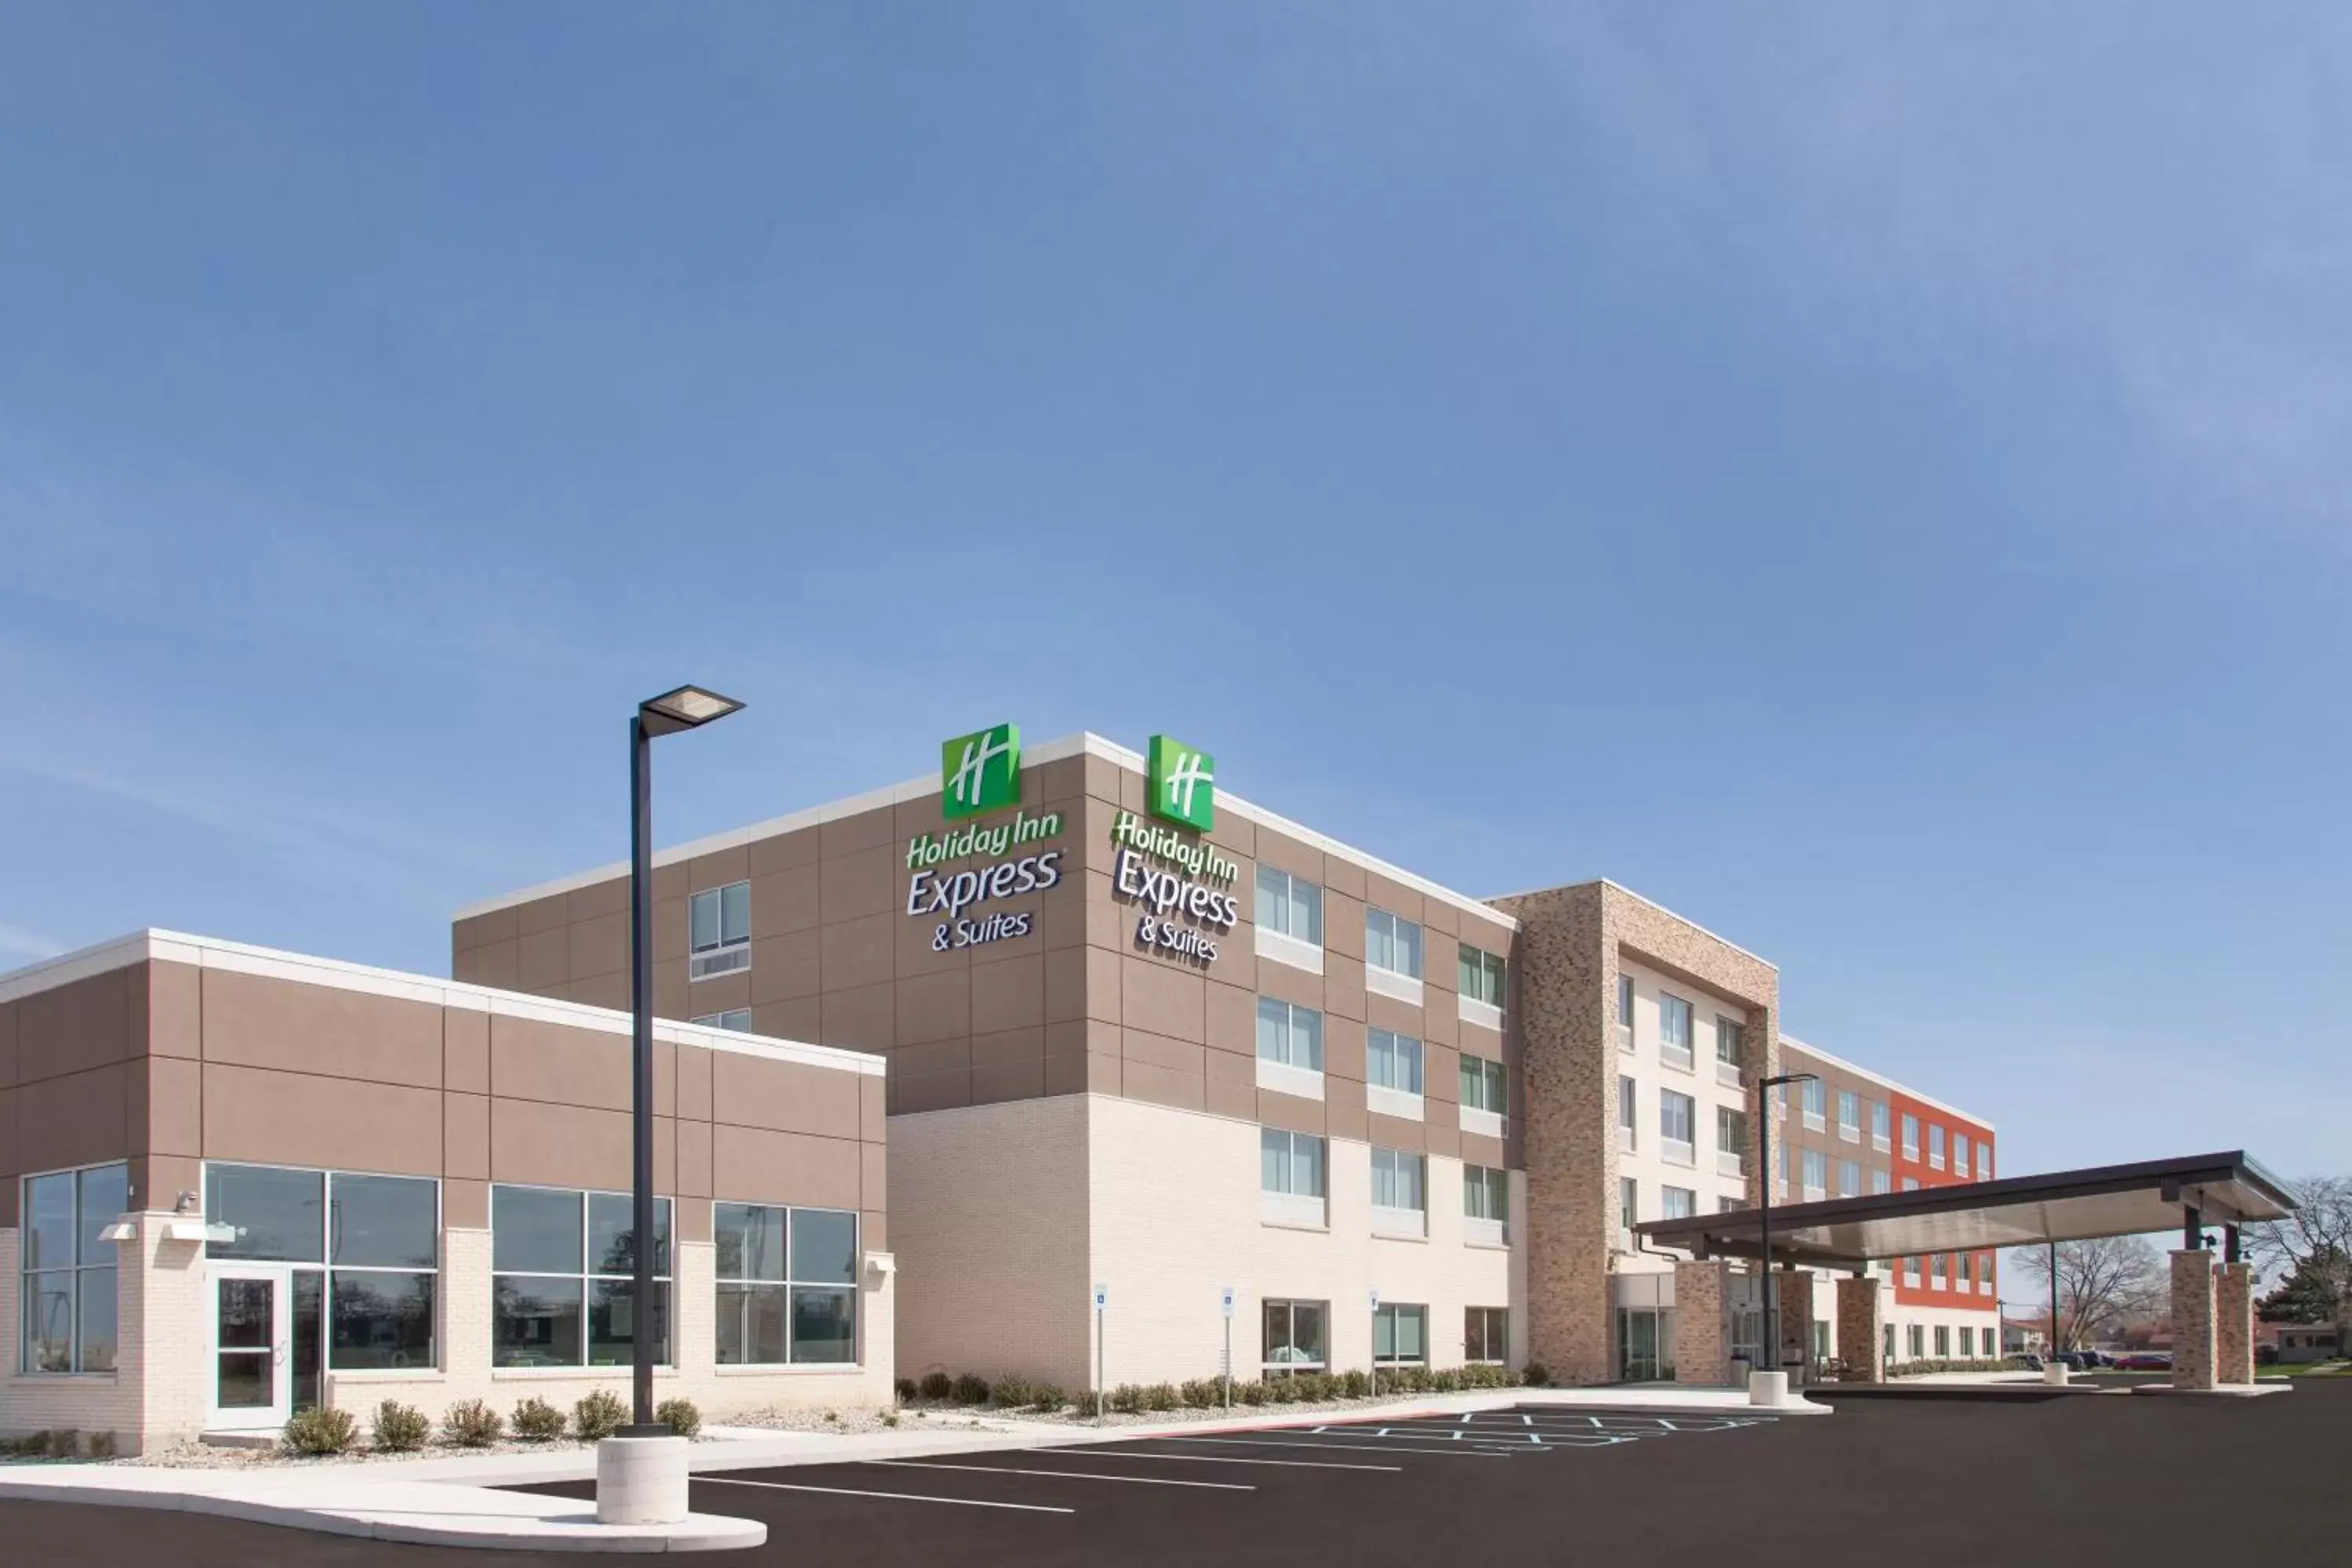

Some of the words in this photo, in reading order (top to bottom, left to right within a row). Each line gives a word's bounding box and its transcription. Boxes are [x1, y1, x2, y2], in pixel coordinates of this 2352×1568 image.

[948, 732, 1009, 805] H
[1166, 753, 1214, 817] H
[906, 823, 1011, 869] Holiday
[1013, 811, 1058, 844] Inn
[1116, 812, 1205, 875] Holiday
[1206, 844, 1239, 882] Inn
[906, 851, 1059, 917] Express
[1118, 849, 1239, 927] Express
[931, 924, 950, 951] &
[955, 912, 1030, 948] Suites
[1141, 916, 1156, 942] &
[1161, 922, 1218, 962] Suites
